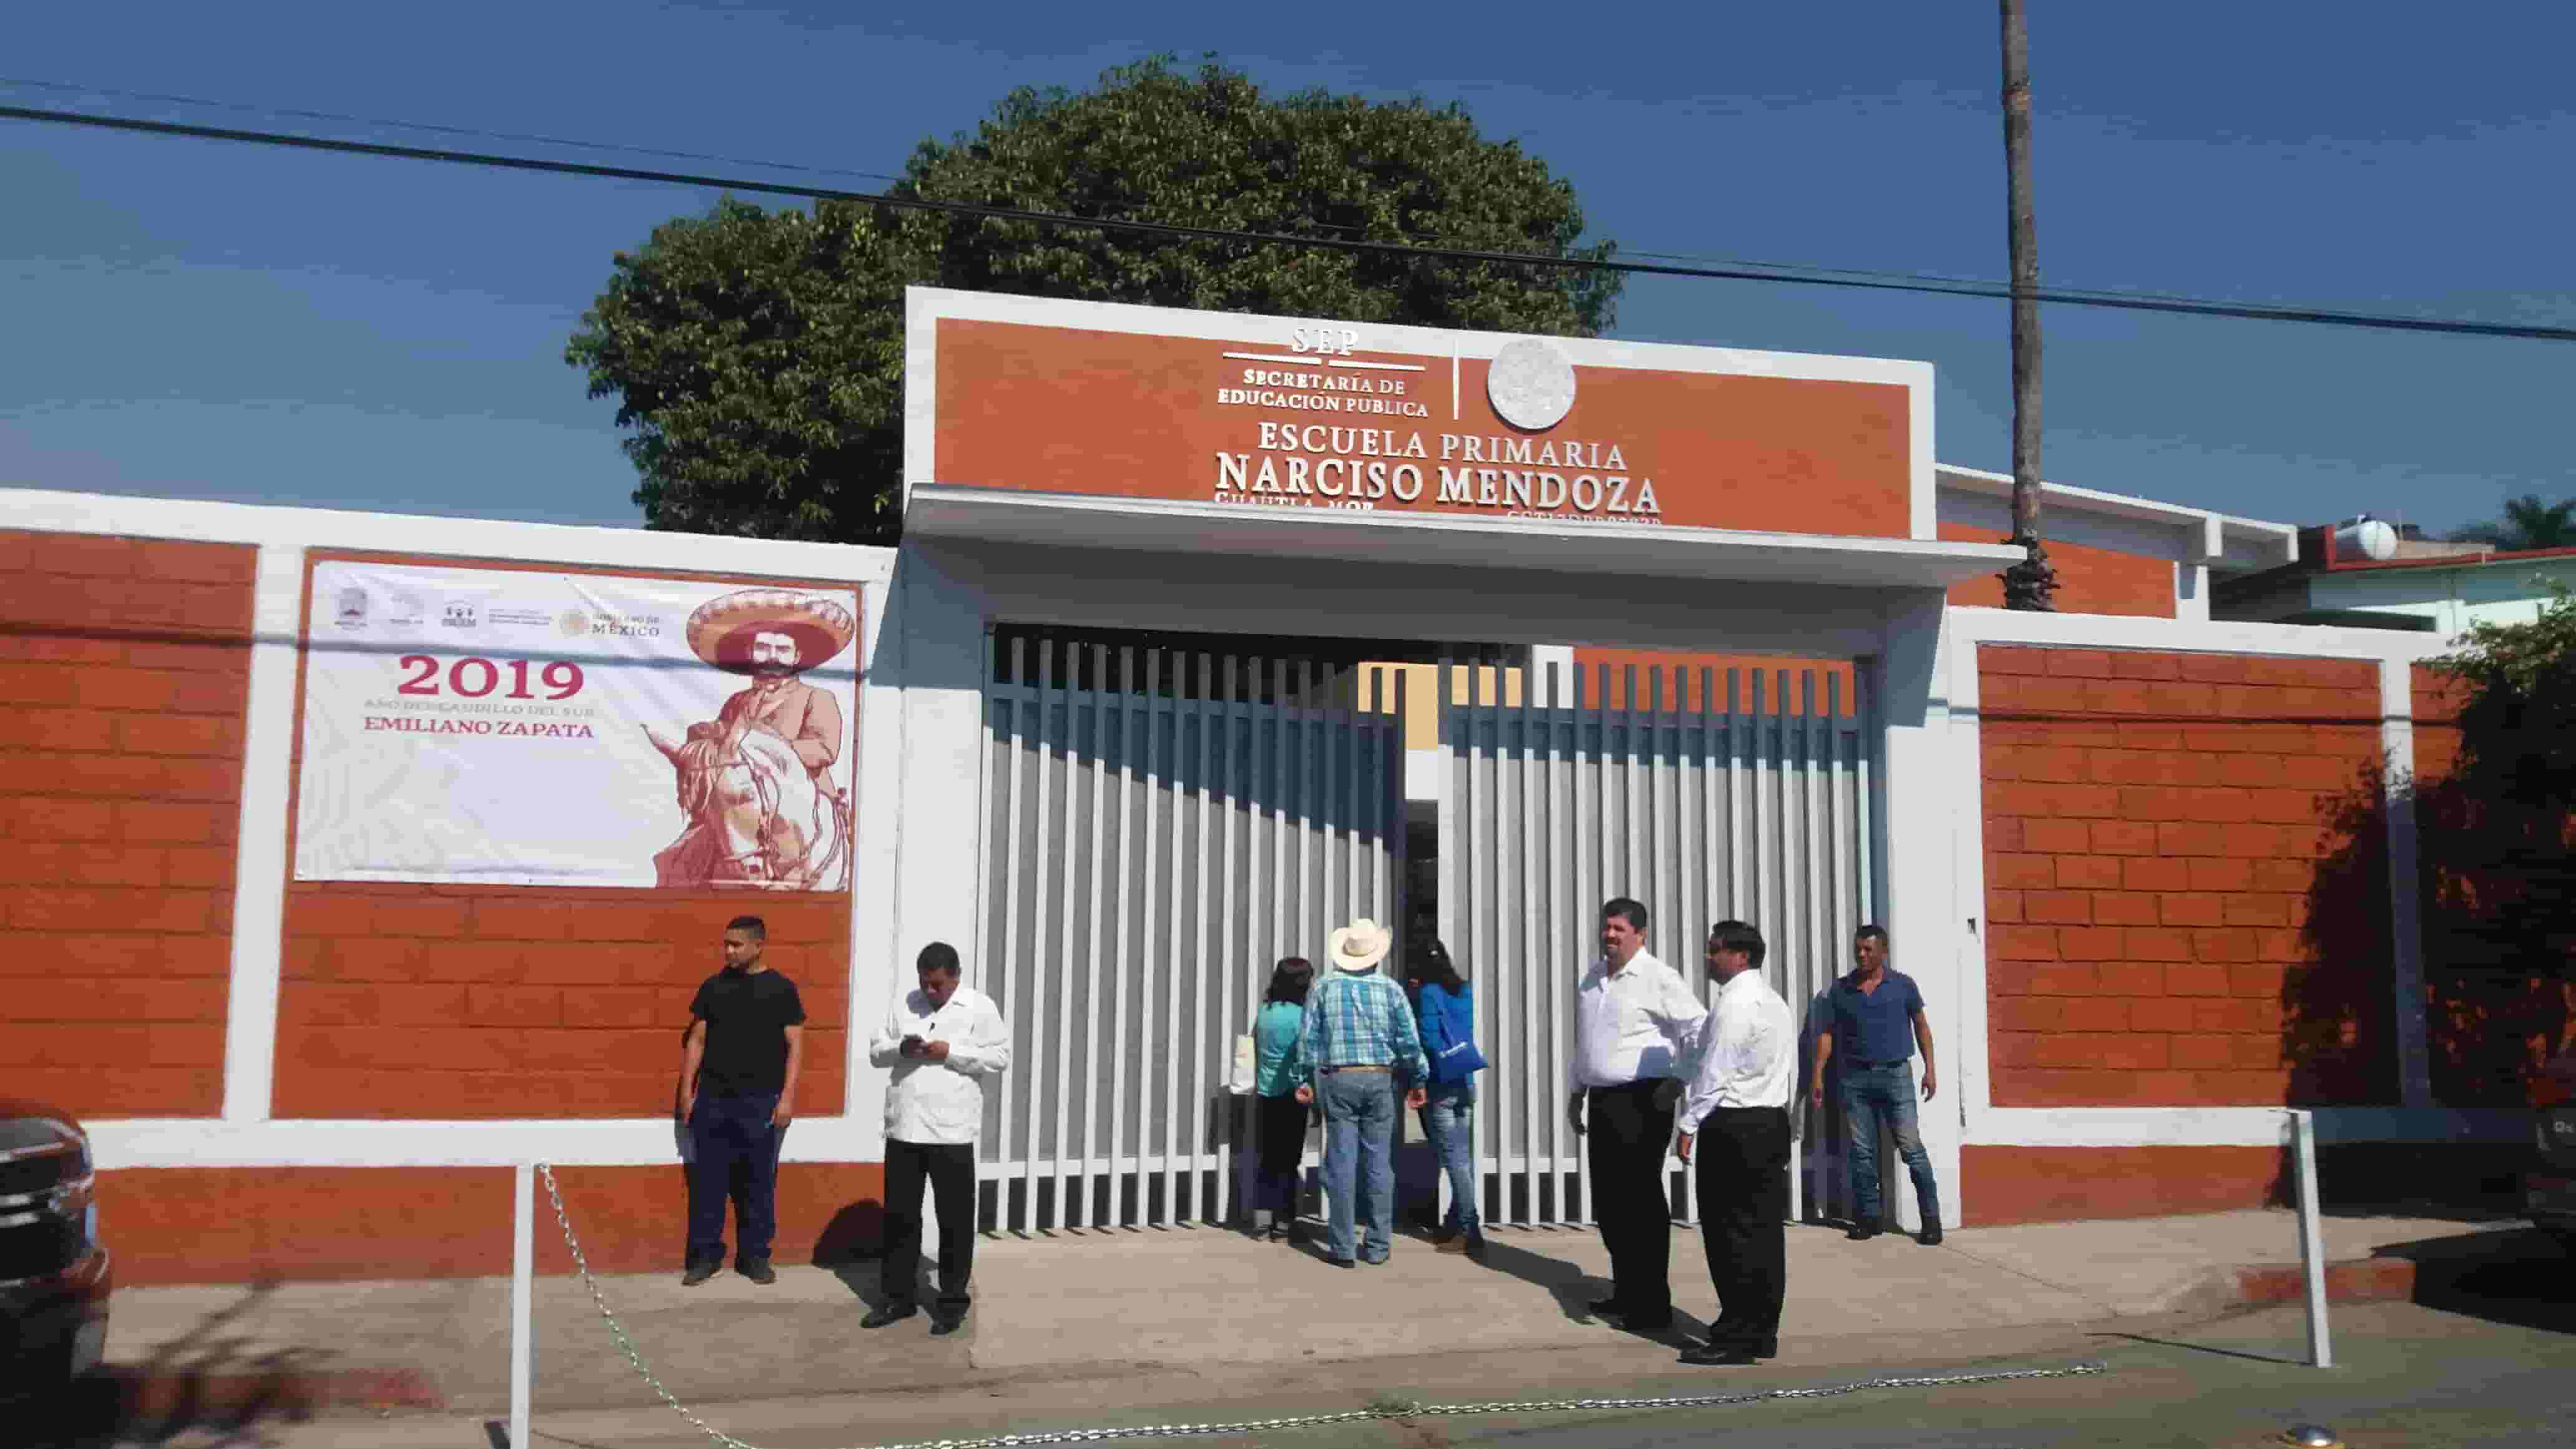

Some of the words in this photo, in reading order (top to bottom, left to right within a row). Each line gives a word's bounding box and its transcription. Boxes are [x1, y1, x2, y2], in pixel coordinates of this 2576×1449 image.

[1291, 327, 1359, 356] SEP
[1243, 369, 1373, 393] SECRETARÍA
[1378, 379, 1406, 395] DE
[1217, 388, 1339, 411] EDUCACIÓN
[1257, 421, 1428, 459] ESCUELA
[1438, 434, 1628, 471] PRIMARIA
[1215, 452, 1423, 502] NARCISO
[1435, 466, 1662, 515] MENDOZA
[397, 655, 585, 700] 2019
[528, 705, 556, 716] DEL
[563, 706, 595, 717] SUR
[364, 716, 491, 734] EMILIANO
[496, 720, 595, 739] ZAPATA
